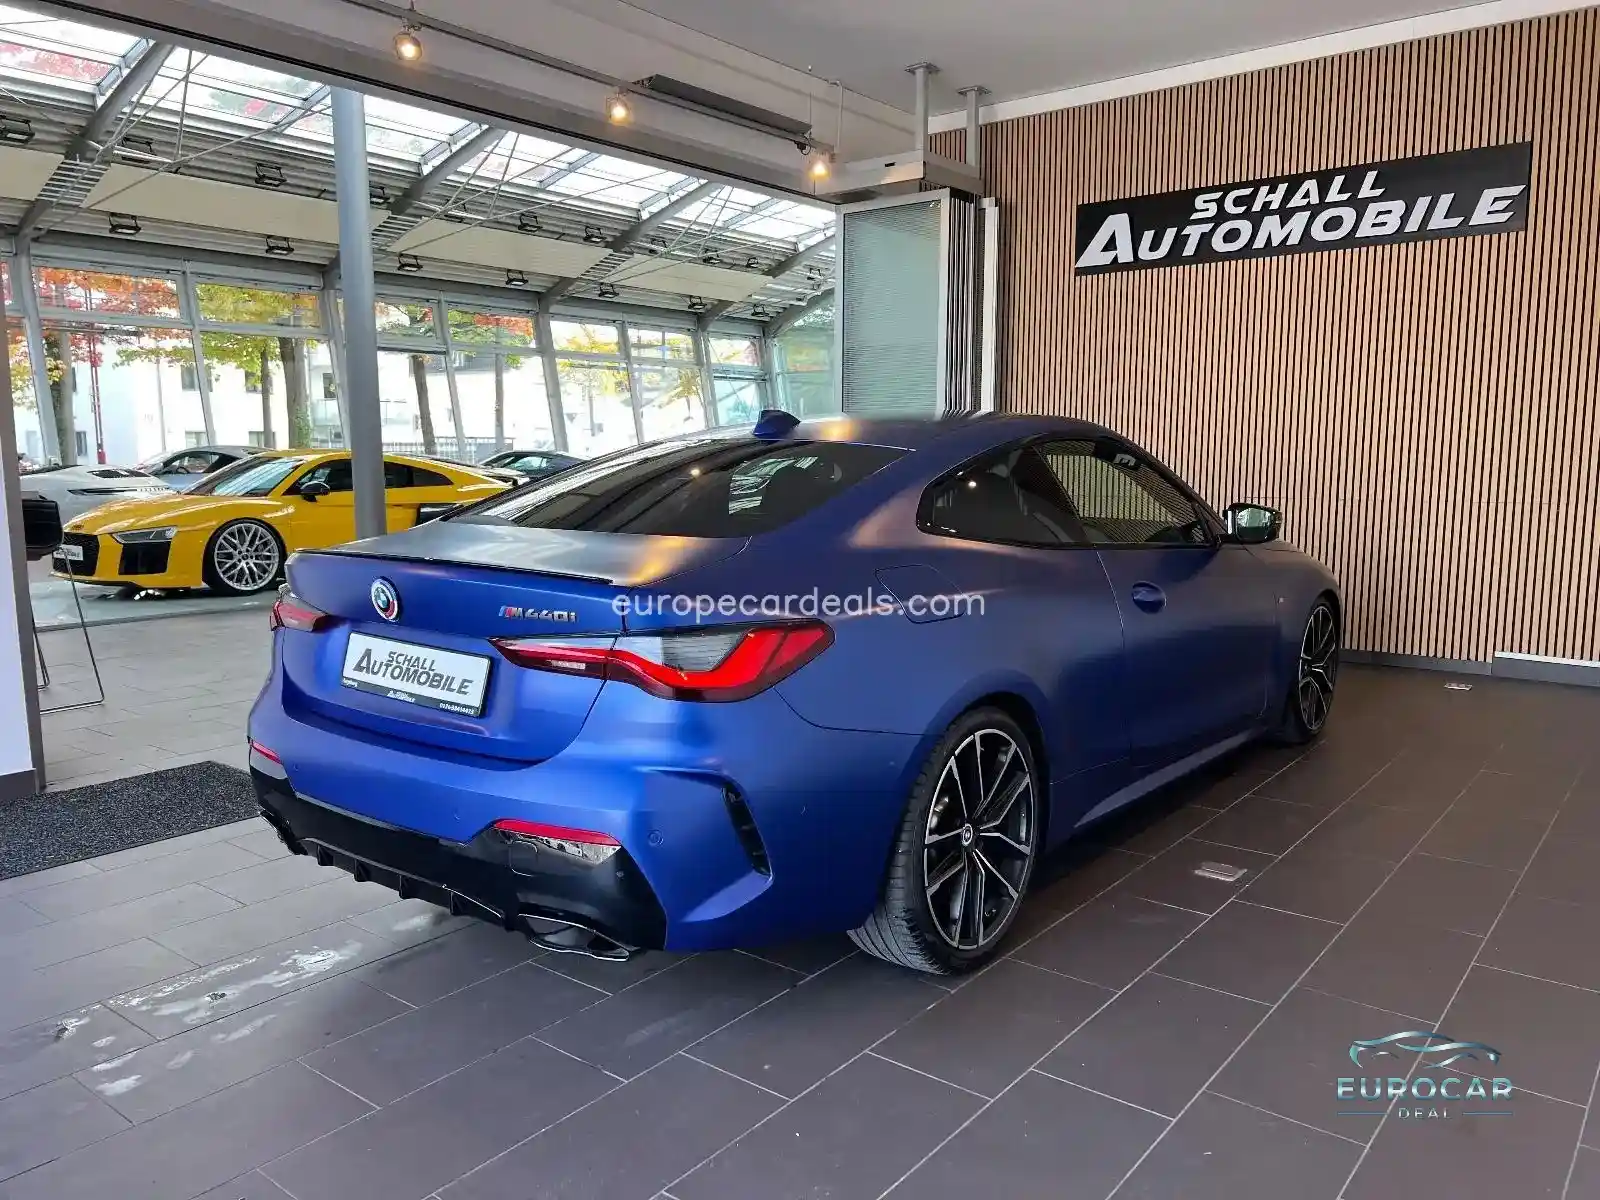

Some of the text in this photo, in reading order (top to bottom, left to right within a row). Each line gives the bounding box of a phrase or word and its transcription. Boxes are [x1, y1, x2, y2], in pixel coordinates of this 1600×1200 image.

[1190, 170, 1385, 220] SCHALL
[1075, 184, 1527, 268] AUTOMOBILE
[499, 605, 577, 622] M440i
[353, 648, 474, 695] AUTOMOBILE
[386, 650, 436, 672] SCHALL
